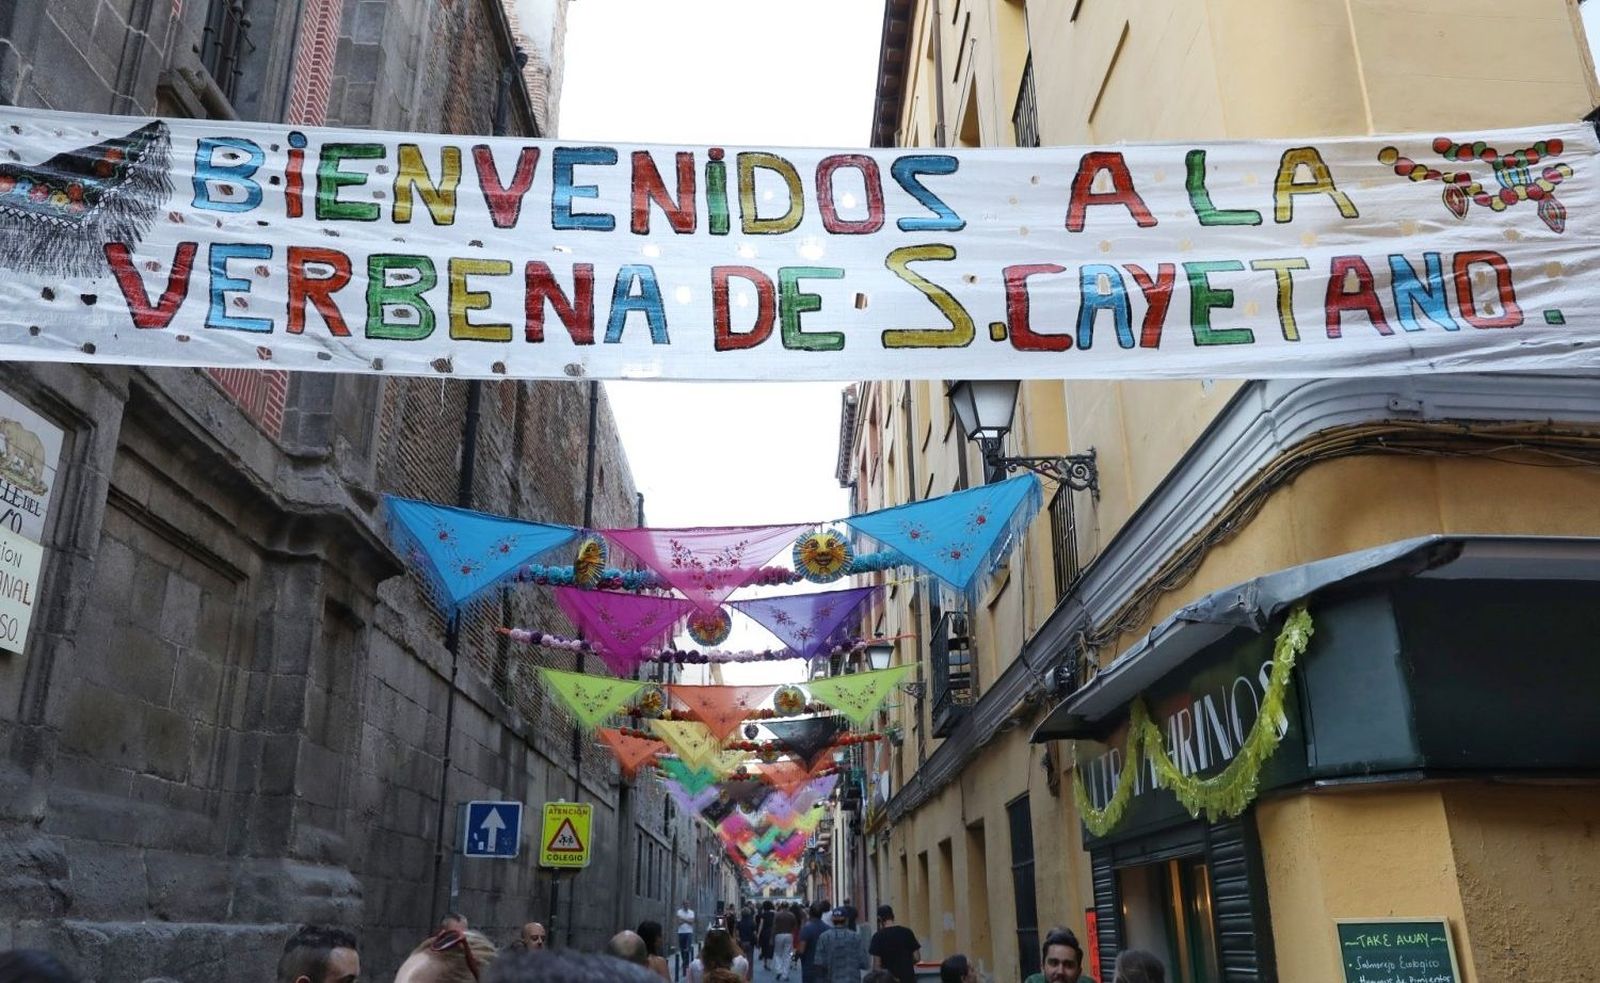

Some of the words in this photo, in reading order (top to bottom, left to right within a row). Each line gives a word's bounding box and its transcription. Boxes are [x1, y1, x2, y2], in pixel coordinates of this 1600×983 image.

[1065, 151, 1159, 232] A
[1185, 146, 1359, 226] LA
[103, 242, 670, 345] VERBENA
[710, 264, 845, 352] DE
[22, 495, 41, 517] DEL
[546, 853, 583, 862] COLEGIO
[1357, 934, 1391, 948] TAKE
[1397, 933, 1430, 948] AWAY
